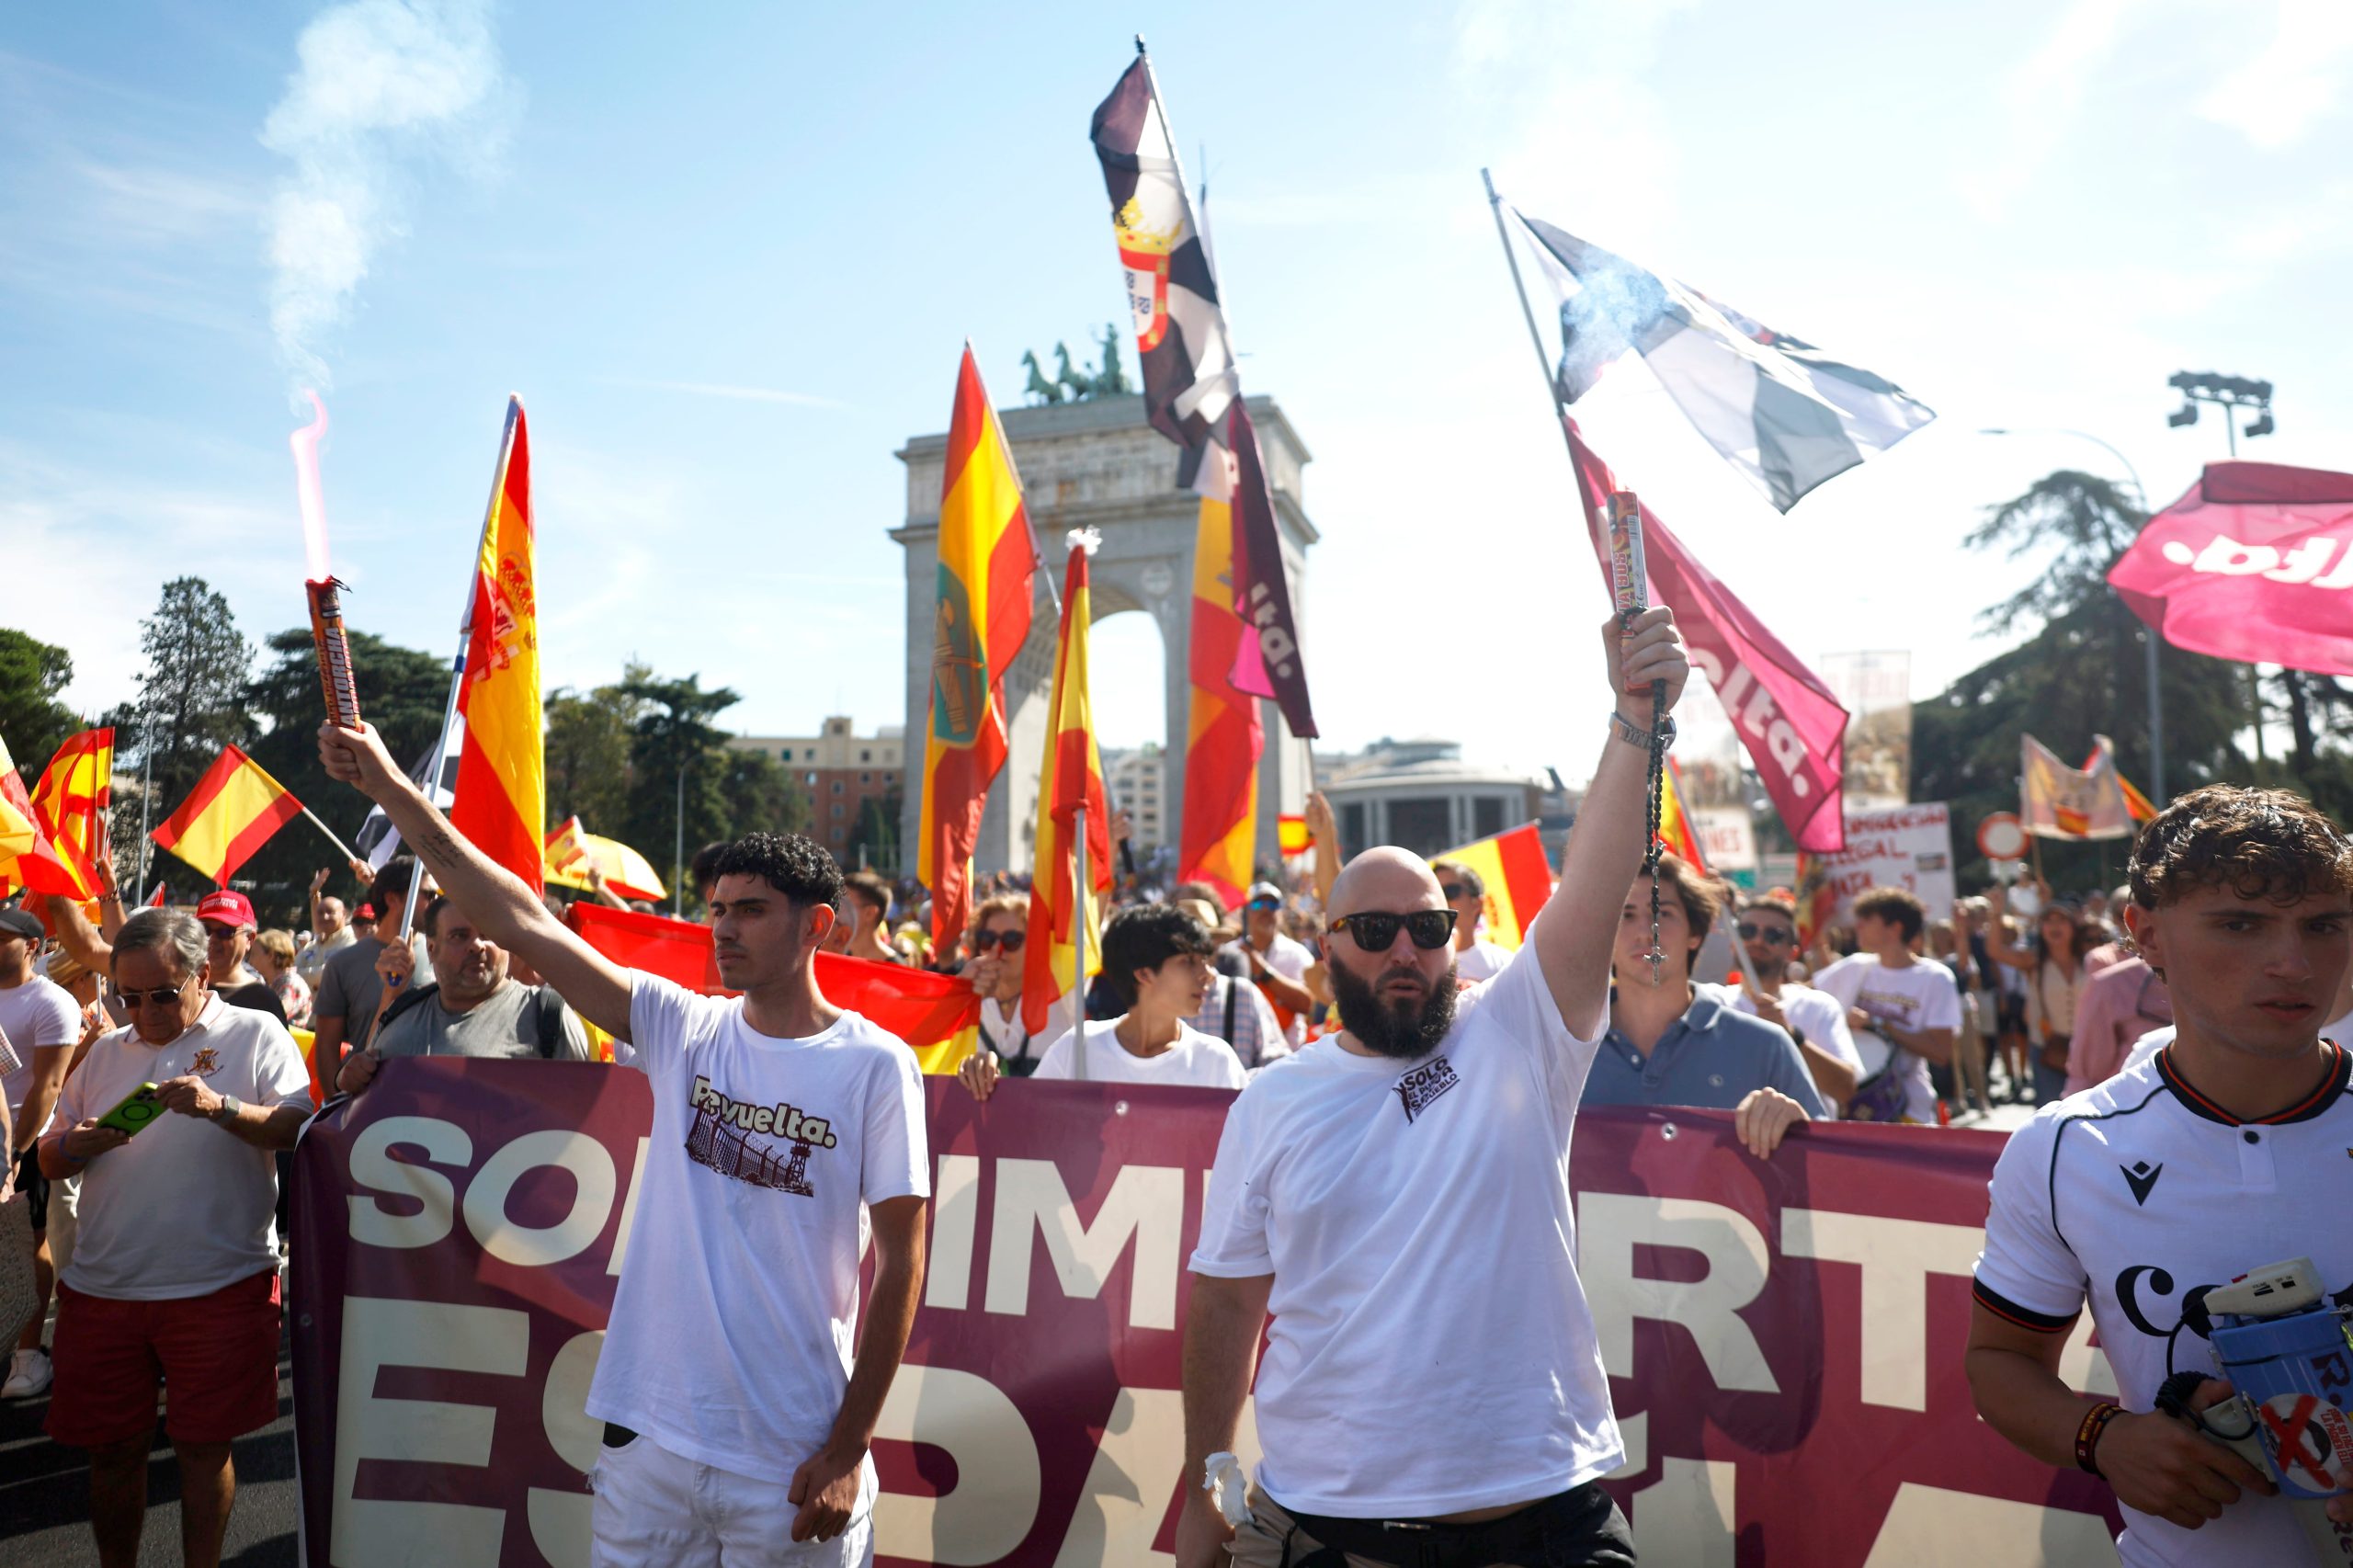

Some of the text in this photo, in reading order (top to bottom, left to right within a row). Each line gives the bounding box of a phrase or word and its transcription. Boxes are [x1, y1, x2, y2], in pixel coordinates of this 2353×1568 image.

[324, 627, 357, 729] ANTORCHA
[1404, 1058, 1449, 1092] SOLO
[1407, 1091, 1419, 1101] EL
